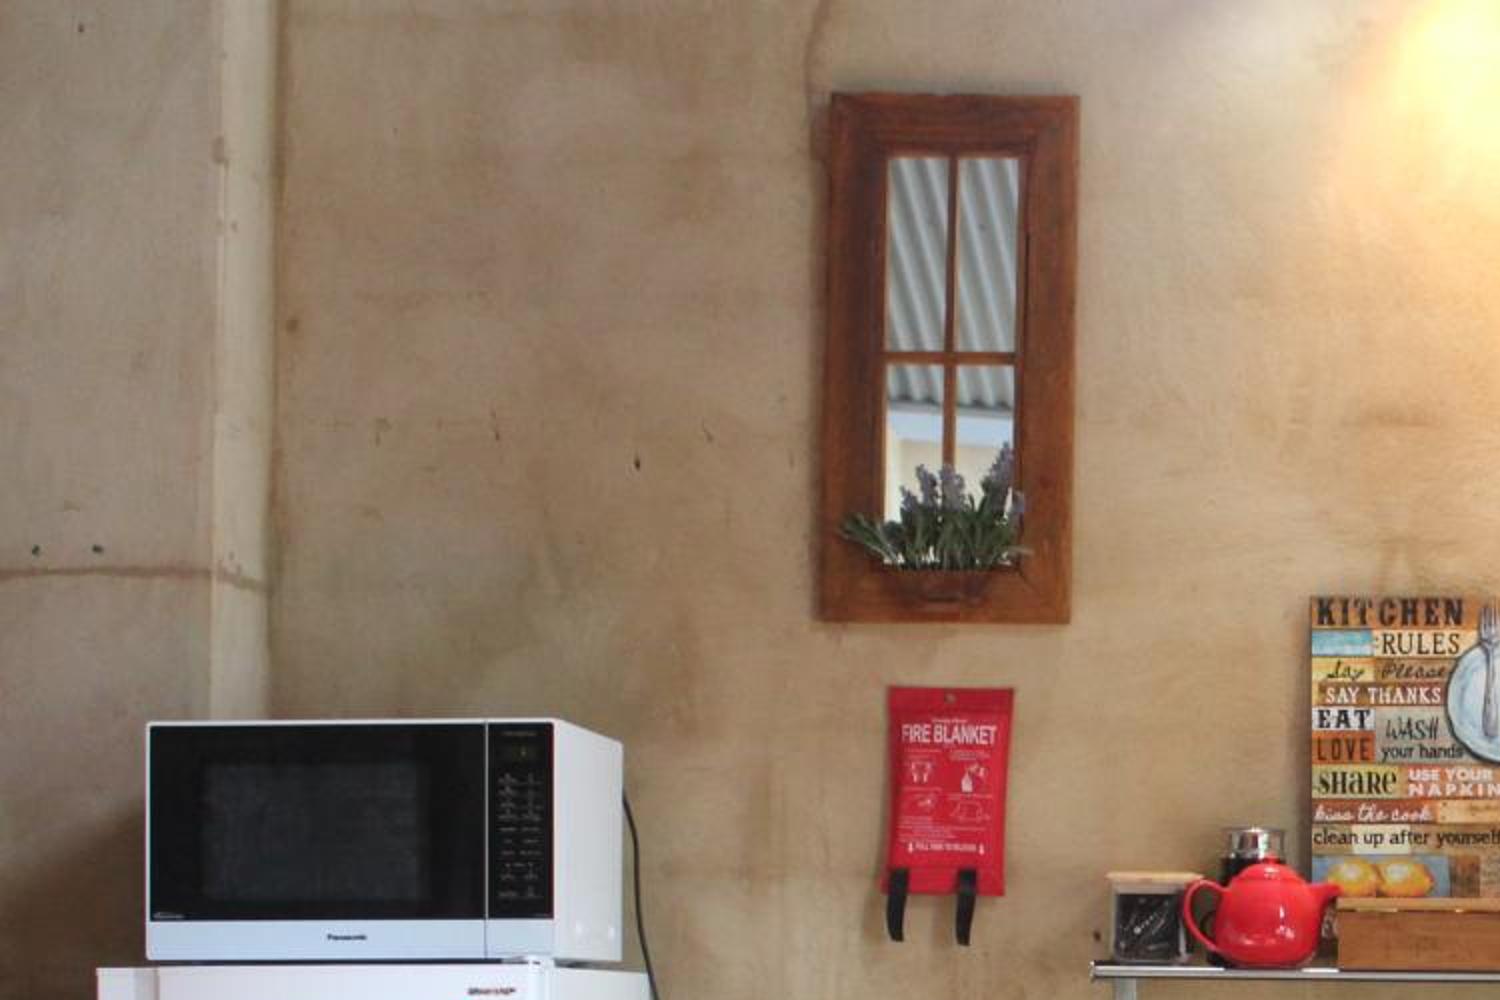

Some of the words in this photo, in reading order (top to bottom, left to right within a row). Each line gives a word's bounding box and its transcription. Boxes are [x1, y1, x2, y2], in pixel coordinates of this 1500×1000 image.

[1316, 598, 1463, 626] KITCHEN
[1382, 633, 1461, 655] RULES
[1325, 687, 1360, 705] SAY
[1367, 687, 1442, 705] THANKS
[1317, 709, 1370, 729] EAT
[1385, 716, 1439, 740] WASH
[901, 723, 931, 743] FIRE
[933, 724, 997, 745] BLANKET
[1317, 737, 1370, 761] LOVE
[1380, 746, 1415, 763] your
[1419, 743, 1464, 759] hands
[1408, 768, 1440, 781] USE
[1445, 767, 1493, 781] YOUR
[1358, 803, 1388, 821] the
[1313, 826, 1358, 846] clean
[1363, 830, 1384, 851] up
[1389, 826, 1429, 845] after
